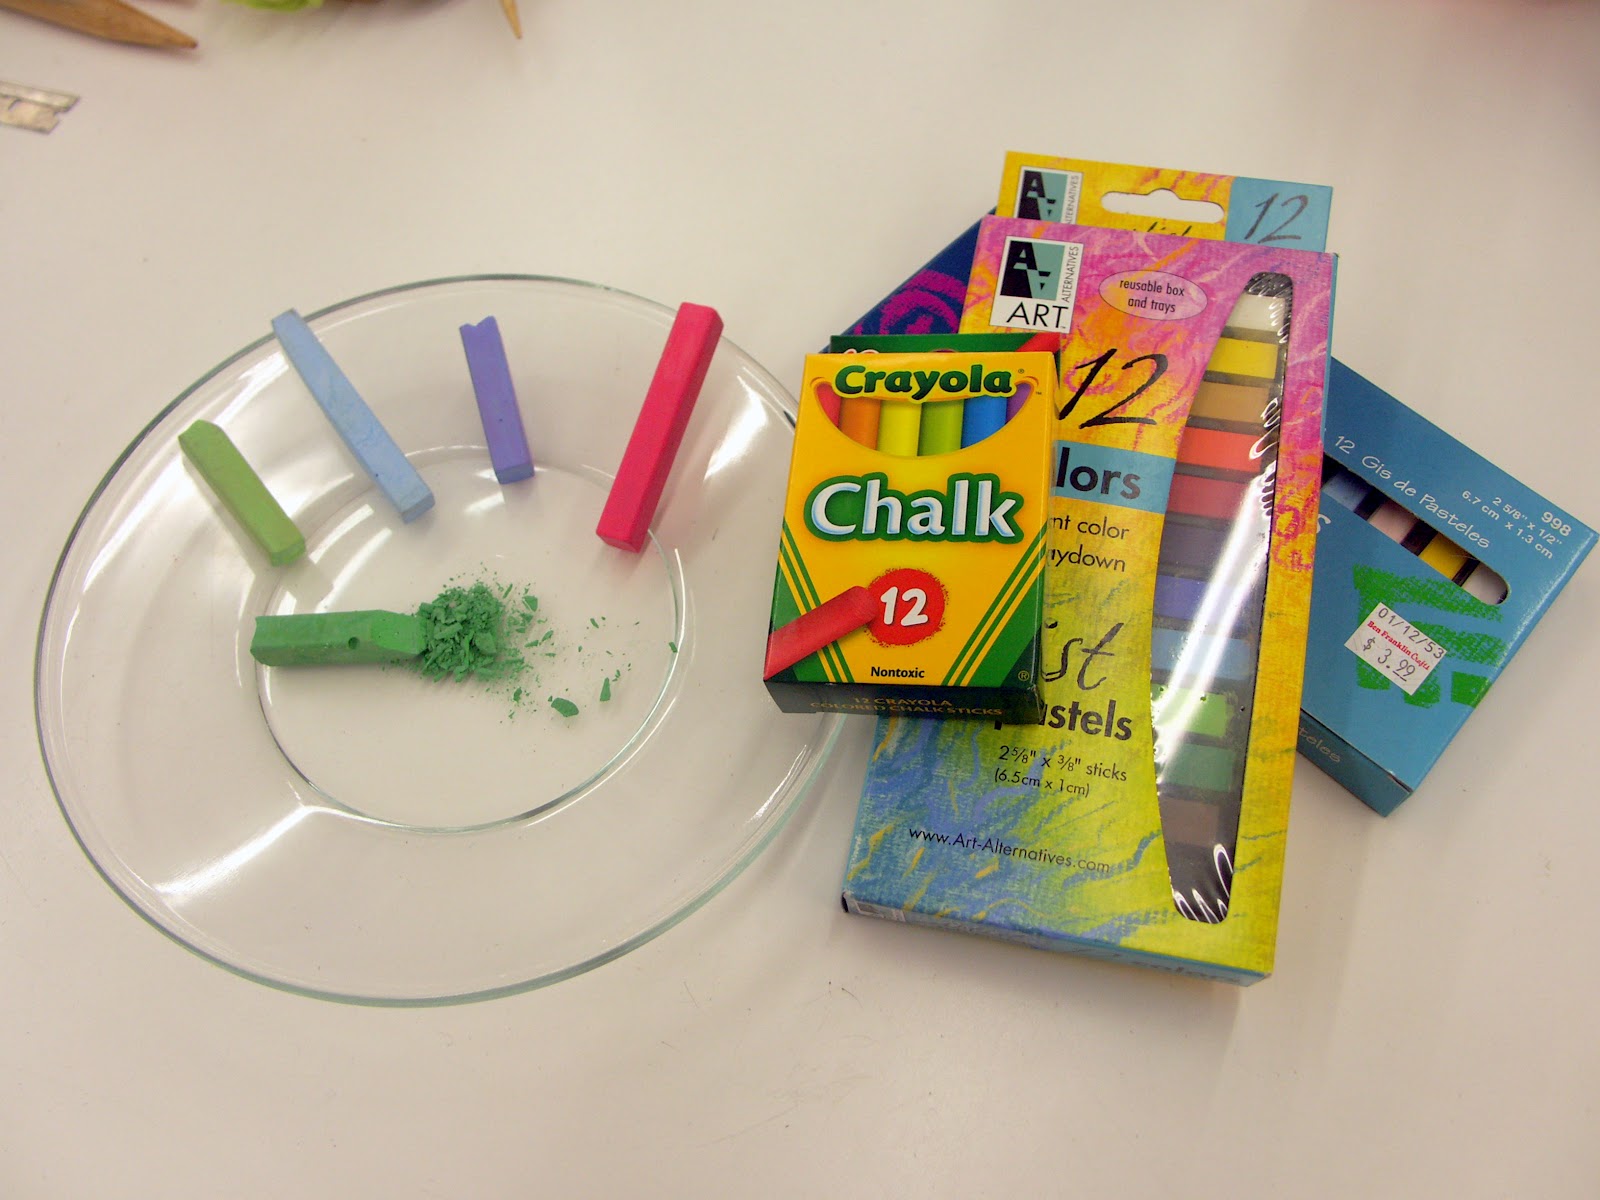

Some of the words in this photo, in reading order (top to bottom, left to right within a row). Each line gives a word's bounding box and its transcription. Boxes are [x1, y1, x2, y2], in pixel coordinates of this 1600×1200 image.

[1245, 193, 1309, 244] 12
[1061, 246, 1079, 303] ALTERNATIVES
[1119, 278, 1163, 294] reusable
[1166, 283, 1186, 297] box
[1006, 301, 1069, 329] ART
[1128, 296, 1149, 310] and
[1150, 299, 1176, 313] trays
[835, 363, 1014, 402] Crayola
[1059, 348, 1168, 429] 12
[1056, 447, 1141, 500] lors
[808, 477, 1019, 538] Chalk
[1334, 435, 1356, 454] 12
[1361, 455, 1392, 480] Gis
[1393, 479, 1417, 497] de
[1419, 493, 1490, 548] Pasteles
[1077, 515, 1130, 539] color
[1462, 490, 1481, 505] 6.7
[1481, 505, 1500, 520] cm
[1504, 522, 1514, 530] x
[1516, 528, 1534, 544] 1.3
[1535, 543, 1553, 559] cm
[1492, 497, 1502, 506] 2
[1527, 522, 1535, 530] x
[1541, 511, 1572, 536] 998
[1051, 544, 1126, 573] ydown
[880, 586, 929, 626] 12
[1367, 620, 1382, 634] Ben
[1381, 630, 1411, 656] Franklin
[1378, 607, 1445, 659] 01/12/53
[870, 666, 925, 678] Nontoxic
[1377, 648, 1416, 680] 3.99
[810, 702, 886, 711] COLORED
[947, 708, 1003, 716] STICKS
[874, 698, 953, 707] CRAYOLA
[994, 699, 1133, 741] stels
[994, 767, 1040, 788] (6.5cm
[1059, 778, 1090, 798] 1cm)
[1086, 763, 1127, 782] sticks
[908, 828, 1111, 873] www.Art-Alternatives.com
